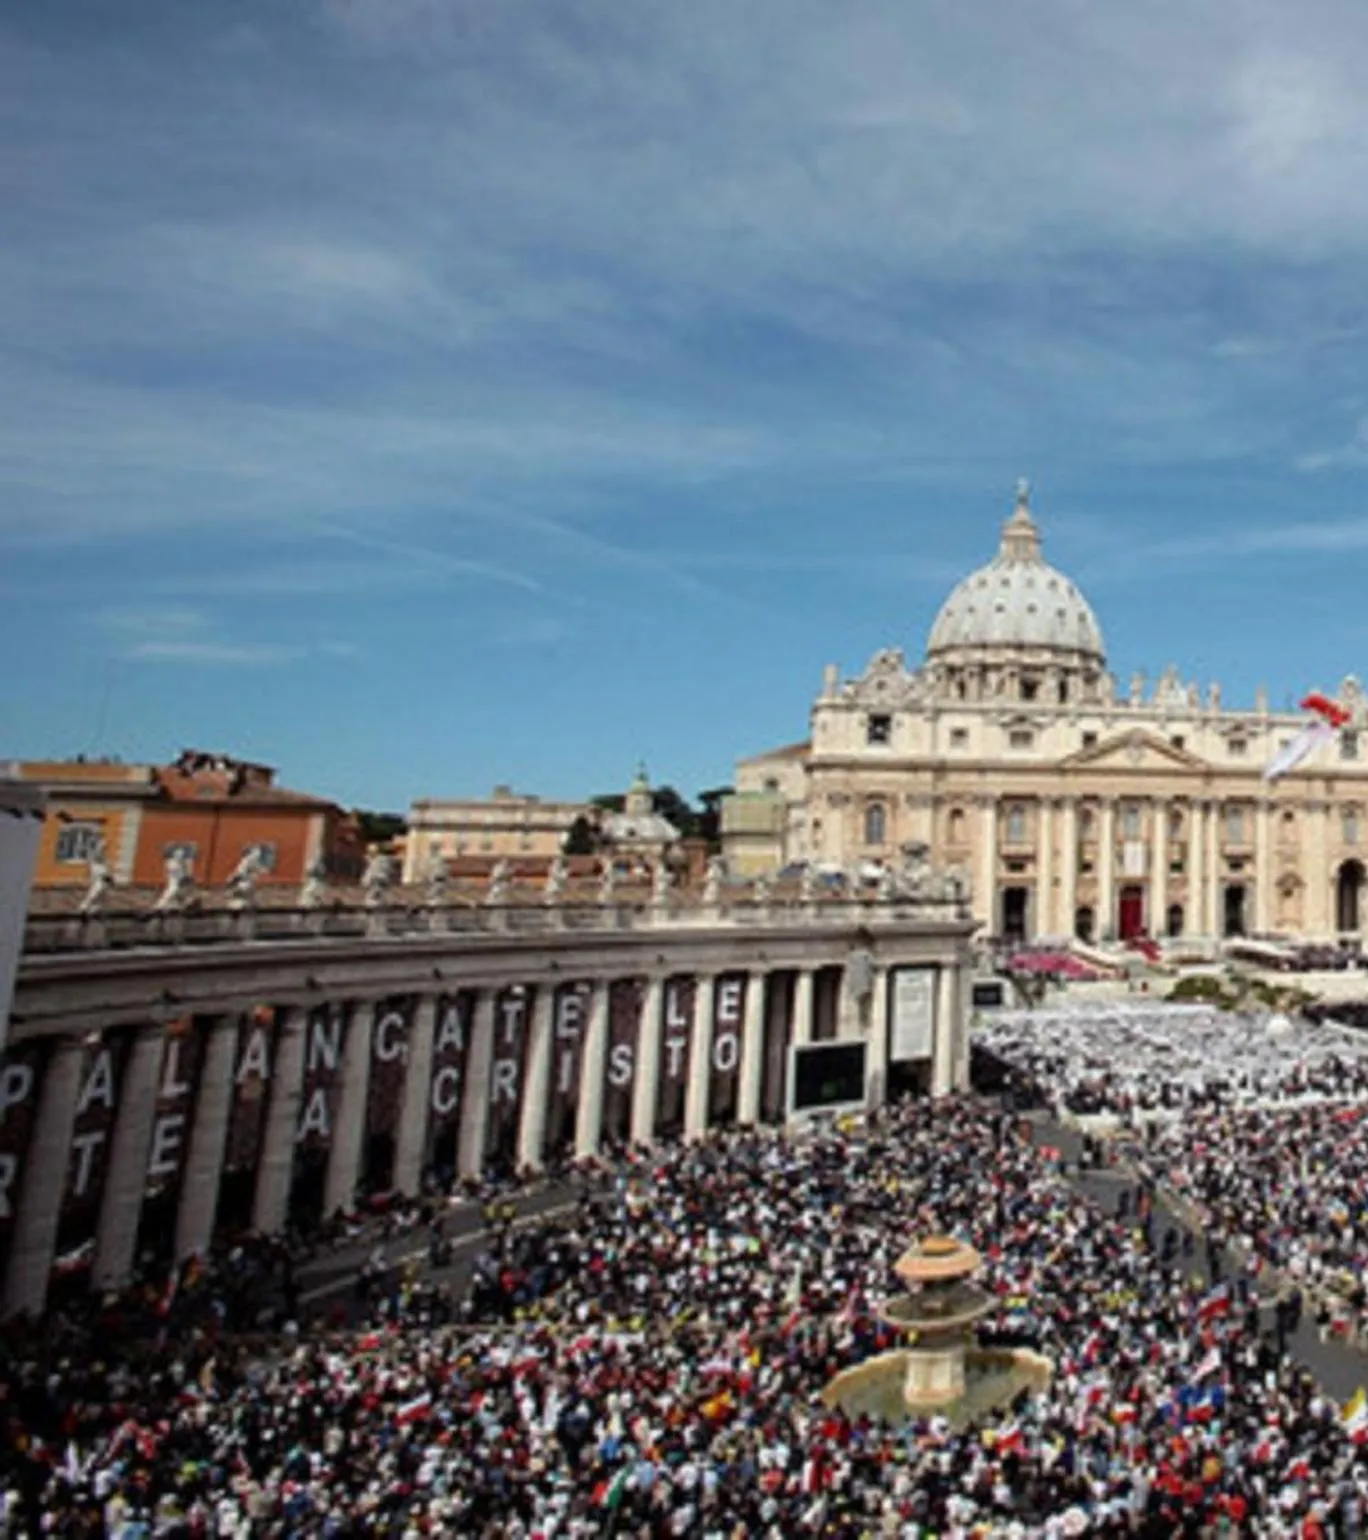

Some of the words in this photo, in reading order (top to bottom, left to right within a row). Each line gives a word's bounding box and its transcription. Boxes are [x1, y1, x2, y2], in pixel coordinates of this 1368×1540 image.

[667, 981, 740, 1027] LE
[300, 1087, 331, 1140] A
[432, 1032, 738, 1113] CRISTO
